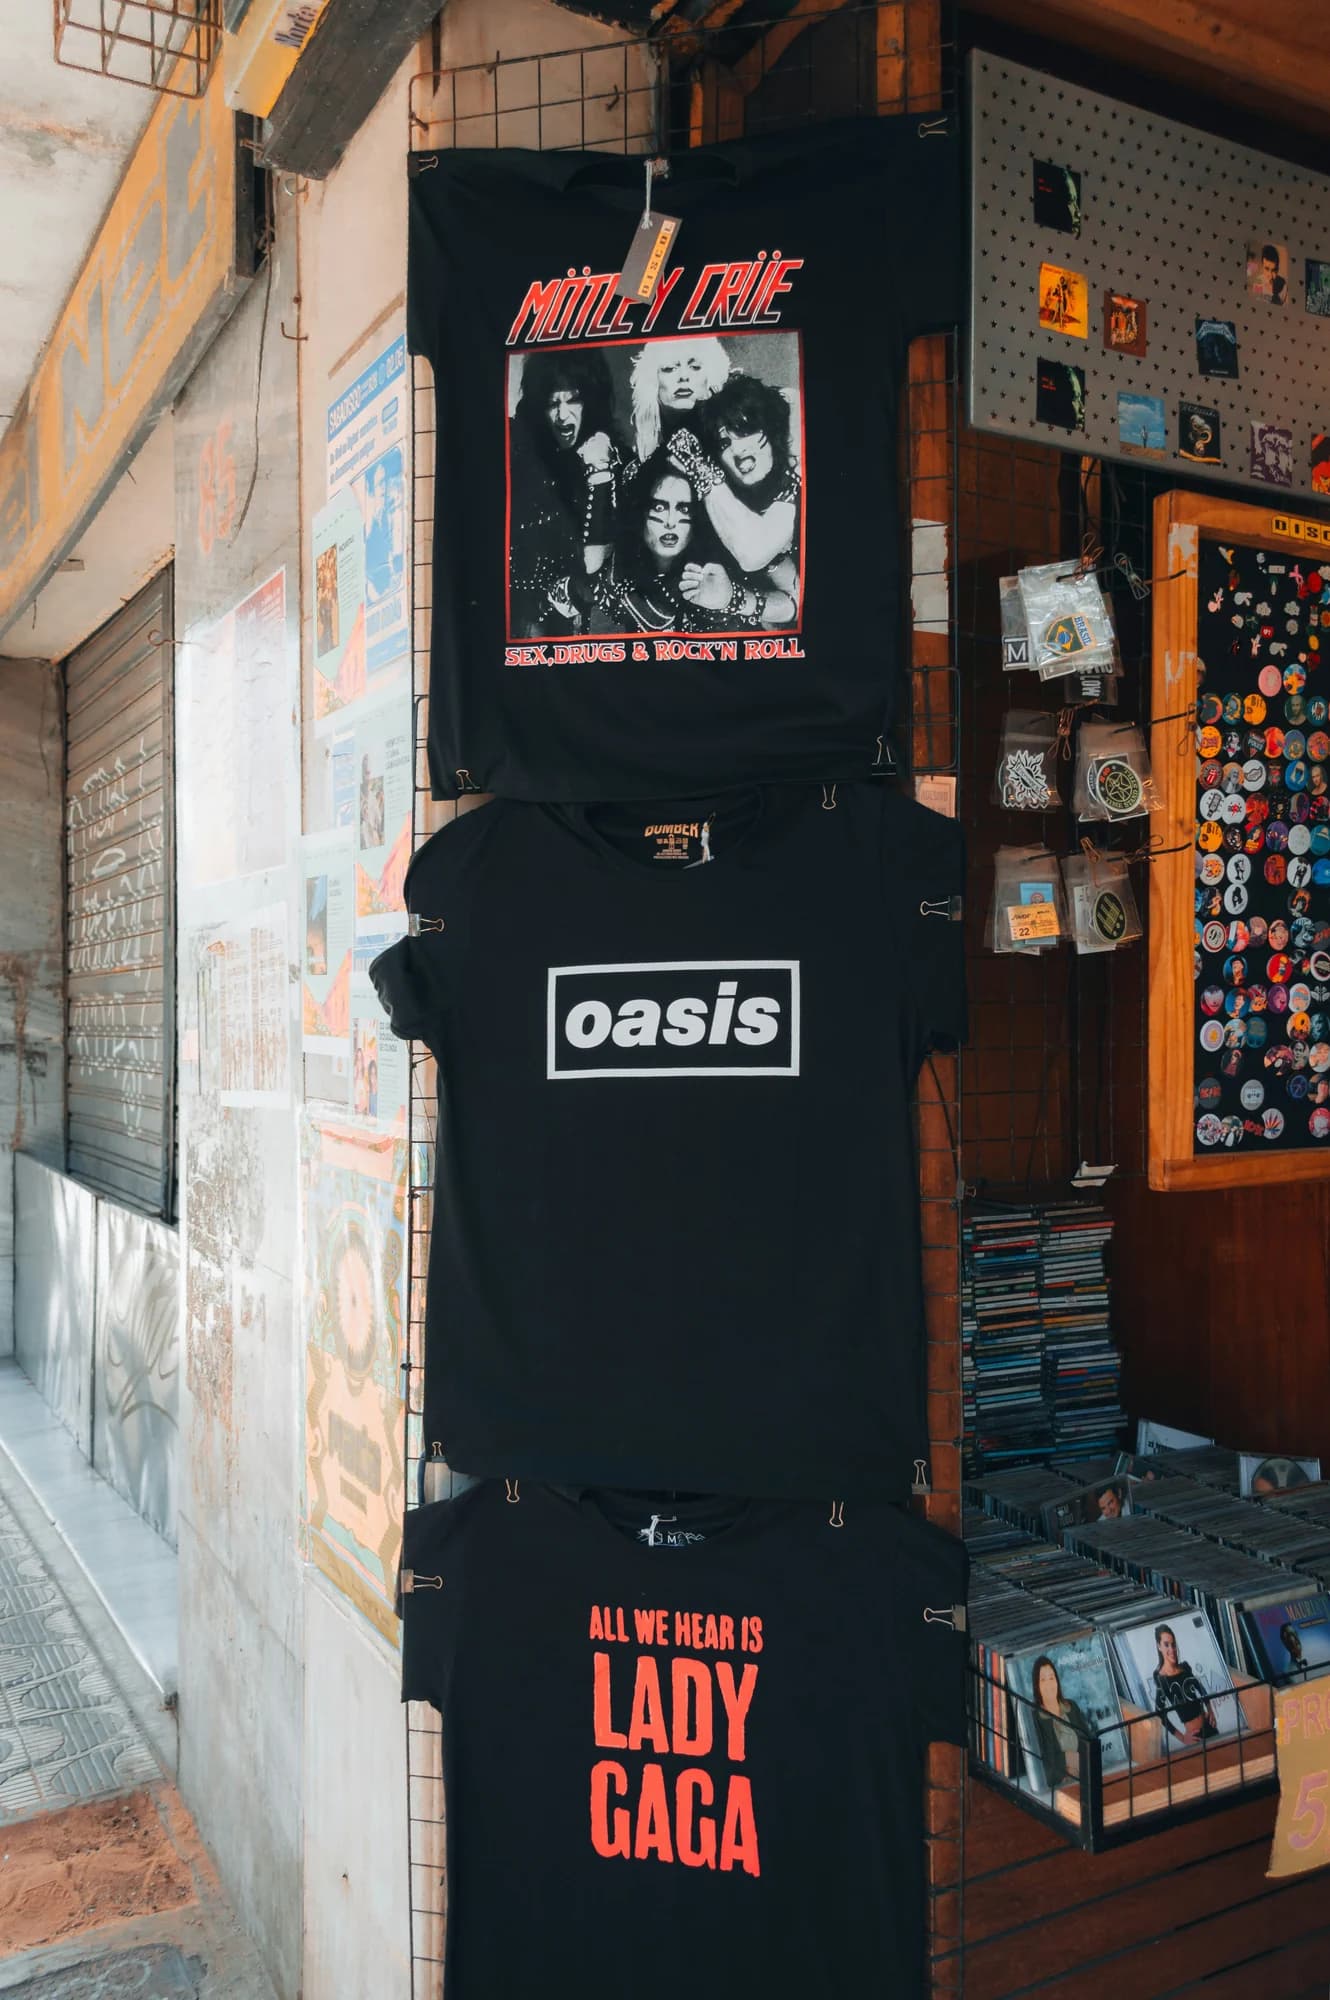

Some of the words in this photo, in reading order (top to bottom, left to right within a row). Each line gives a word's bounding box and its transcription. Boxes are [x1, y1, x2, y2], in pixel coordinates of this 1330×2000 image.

[678, 250, 804, 330] CRÜE
[632, 642, 649, 662] &
[655, 640, 737, 662] ROCK'N
[744, 638, 805, 660] ROLL
[1019, 928, 1031, 937] 22
[565, 981, 781, 1049] oasis
[589, 1605, 630, 1643] ALL
[633, 1608, 669, 1646] WE
[675, 1611, 735, 1651] HEAR
[741, 1616, 764, 1654] IS
[593, 1651, 759, 1762] LADY
[1284, 1688, 1330, 1745] PR
[590, 1759, 761, 1878] GAGA
